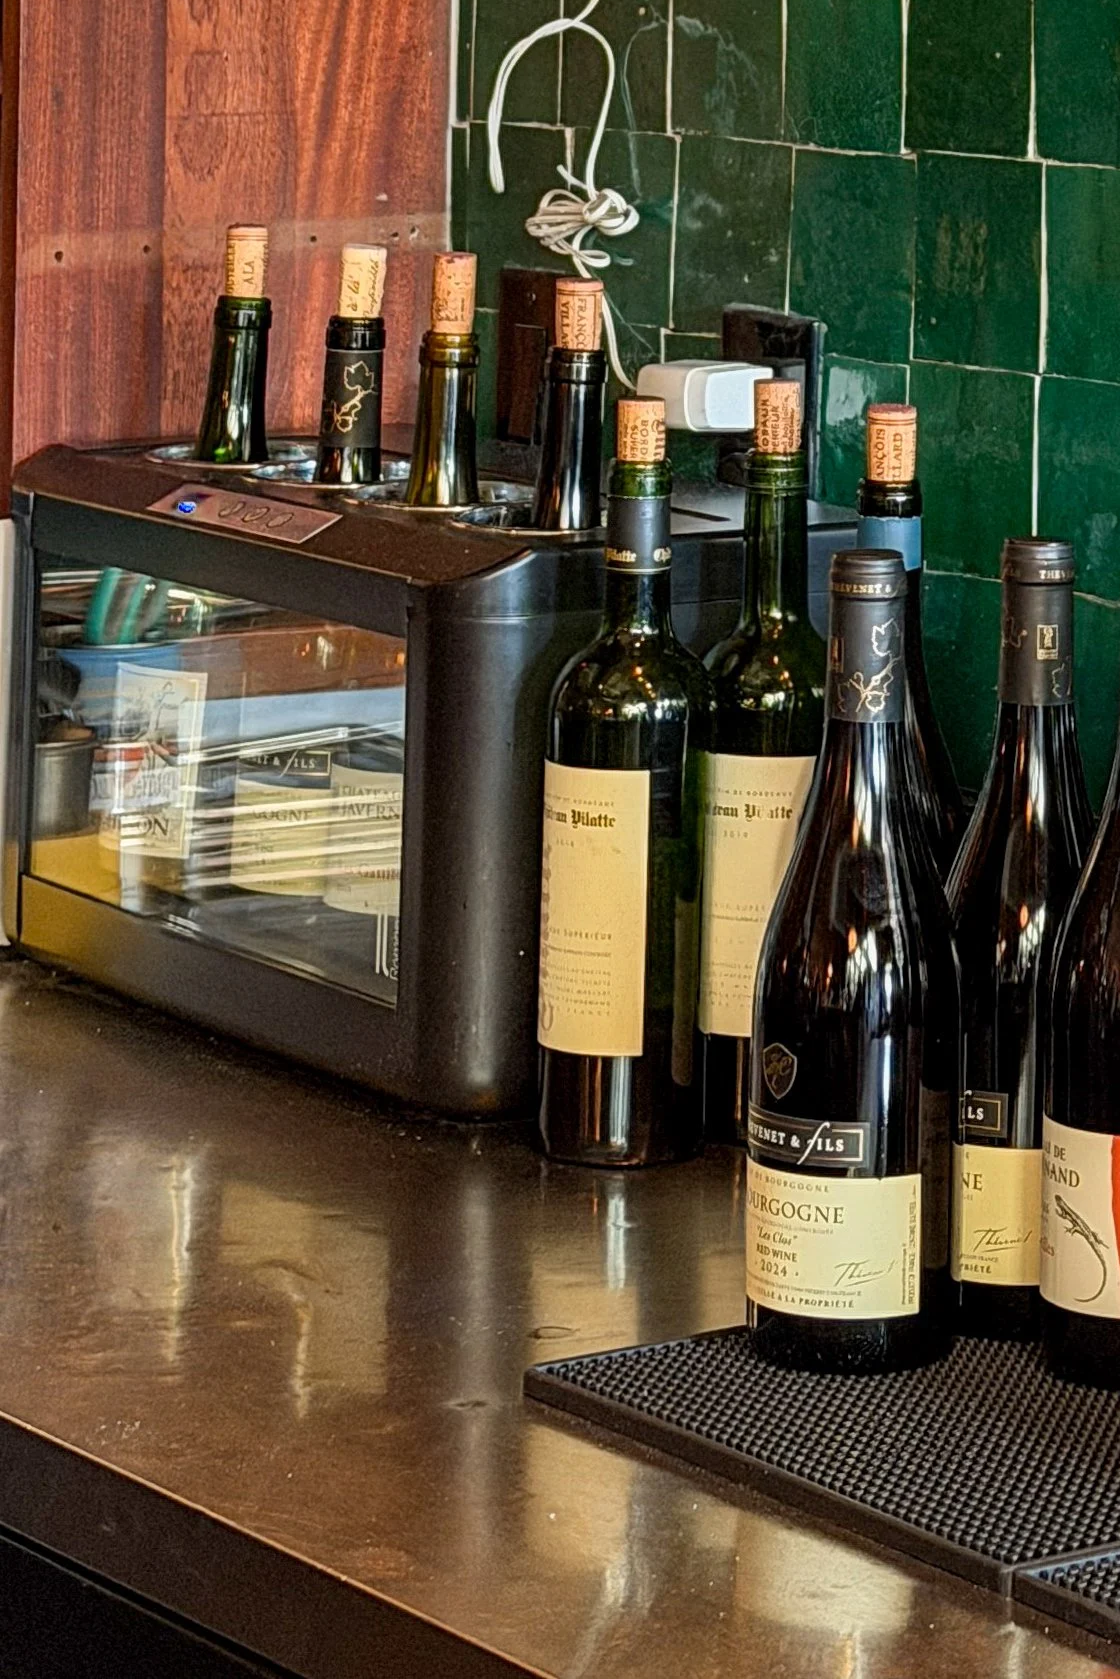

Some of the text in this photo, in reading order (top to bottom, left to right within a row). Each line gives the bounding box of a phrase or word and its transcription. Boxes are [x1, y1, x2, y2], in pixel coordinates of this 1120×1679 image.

[790, 1138, 800, 1148] &
[1053, 1144, 1067, 1162] DE
[765, 1176, 829, 1193] BOURGOGNE
[756, 1243, 798, 1263] RED WINE
[760, 1259, 788, 1278] 2024
